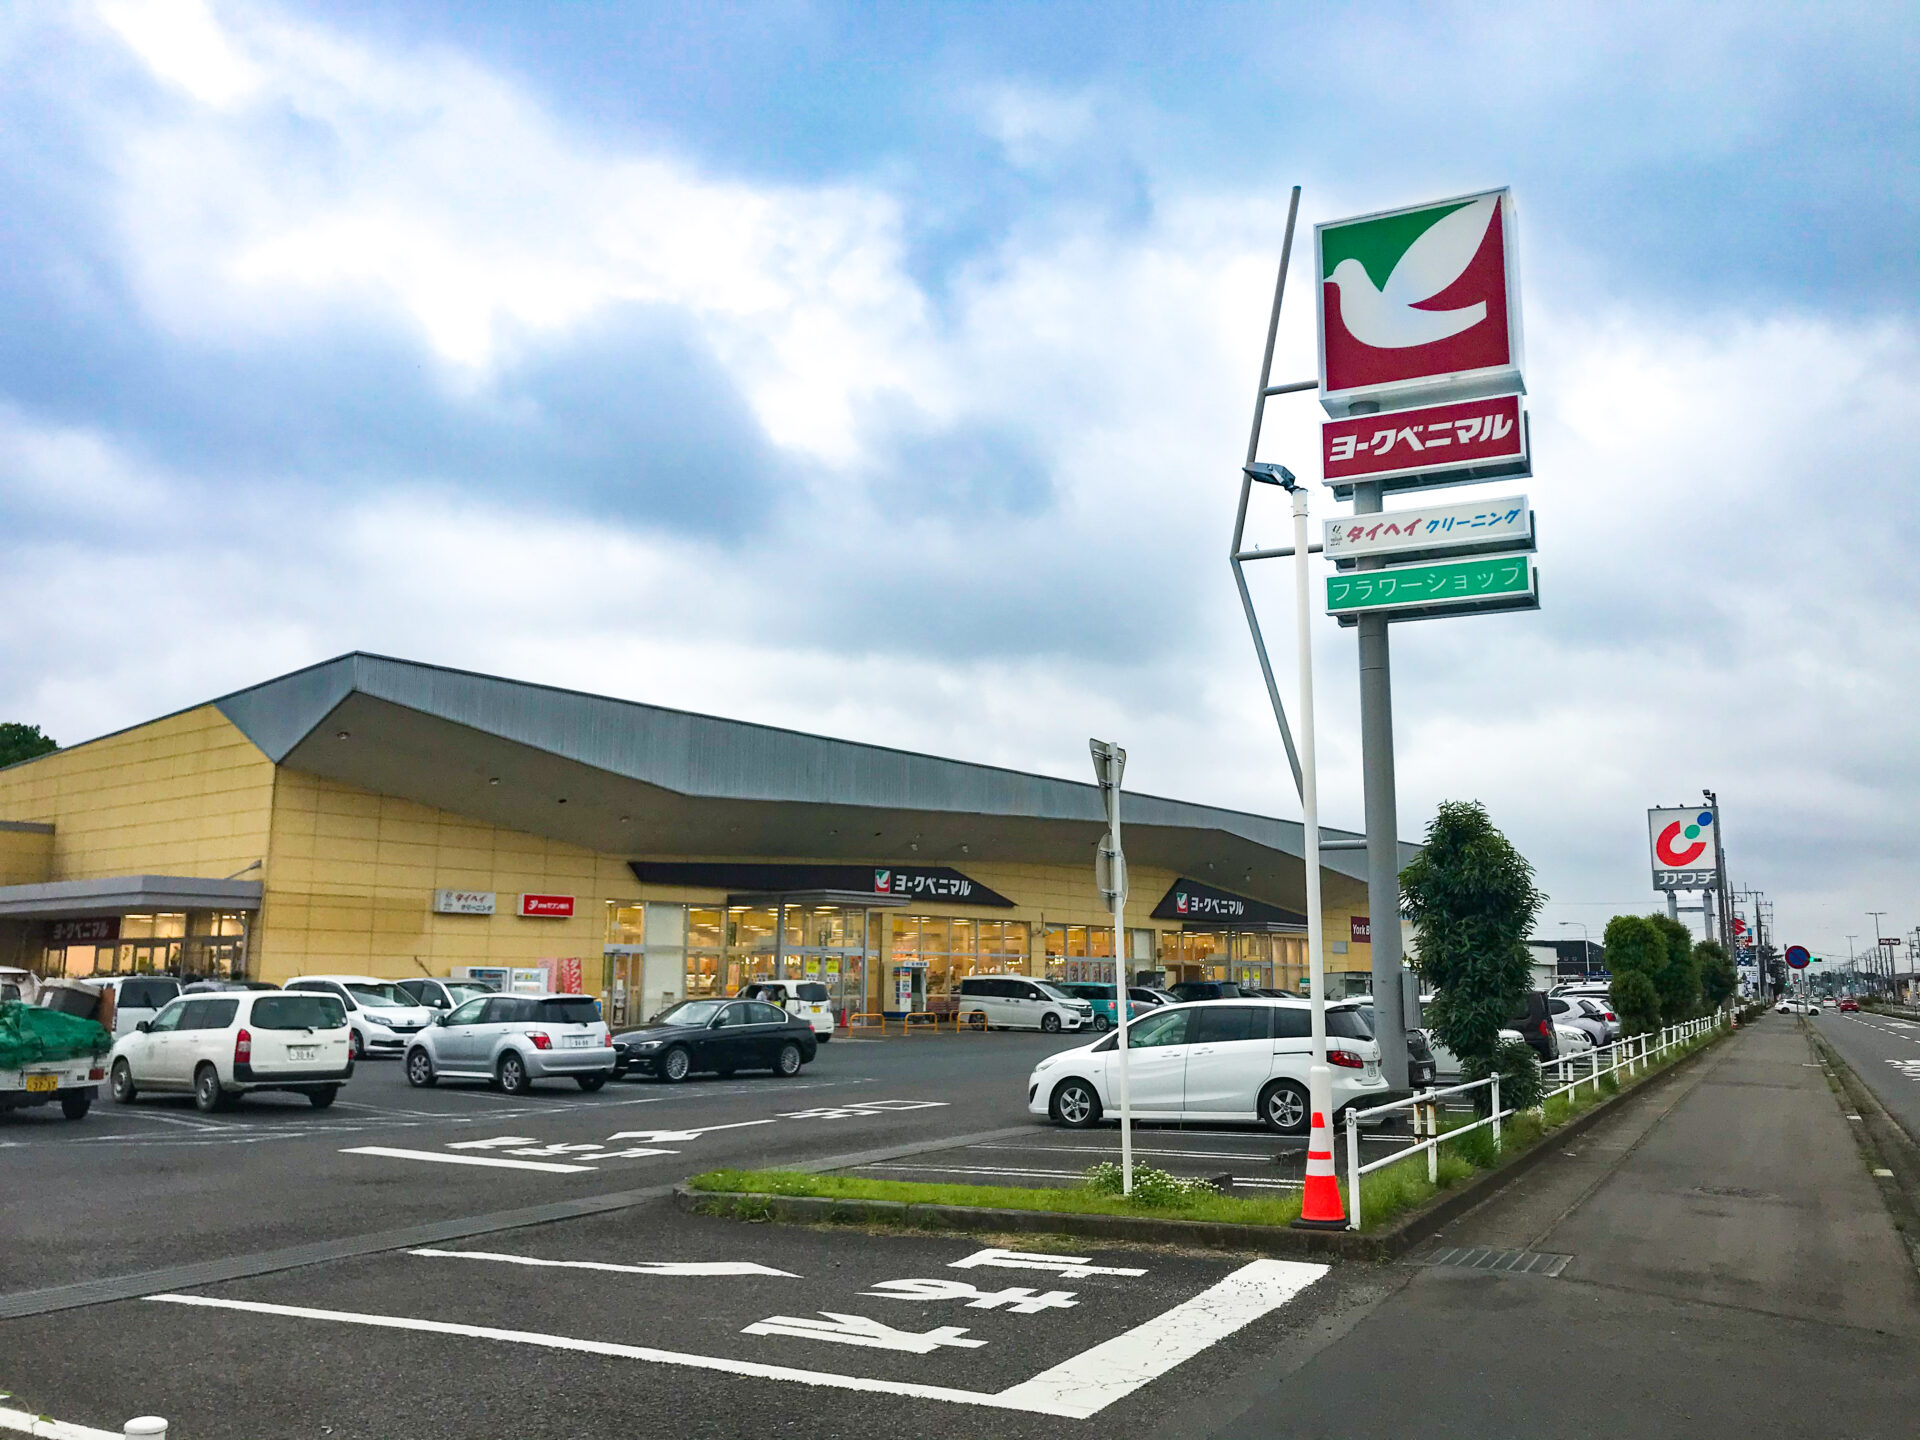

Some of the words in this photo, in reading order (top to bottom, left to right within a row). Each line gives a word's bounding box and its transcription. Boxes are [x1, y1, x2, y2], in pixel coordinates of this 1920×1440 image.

[1329, 414, 1513, 462] ヨークベニマル
[1347, 518, 1422, 542] タイヘイ
[1425, 509, 1520, 533] クリーニング
[1333, 562, 1523, 601] フラワーショップ
[895, 874, 972, 896] ヨークベニマル
[1659, 871, 1716, 885] カワチ
[1190, 897, 1244, 915] ヨークベニマル
[1353, 924, 1366, 935] York
[739, 1248, 1149, 1354] 止まれ
